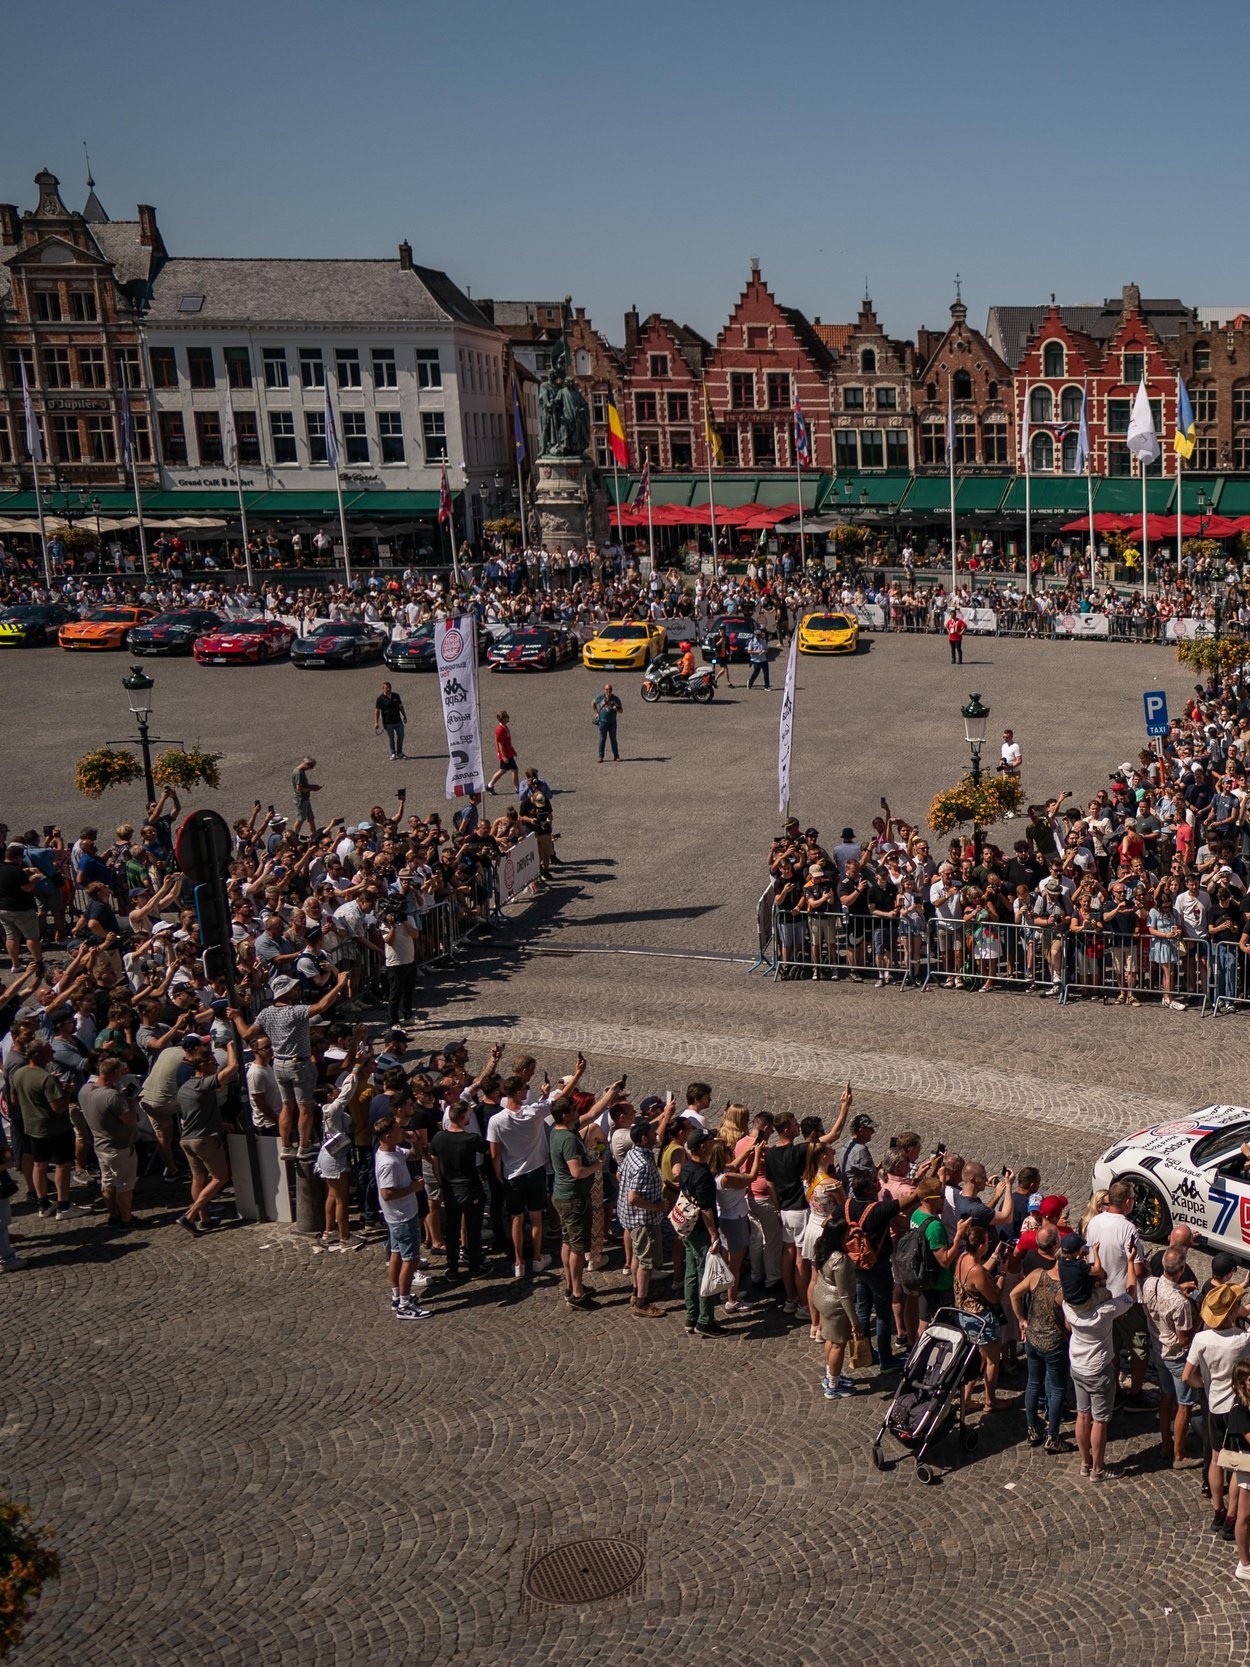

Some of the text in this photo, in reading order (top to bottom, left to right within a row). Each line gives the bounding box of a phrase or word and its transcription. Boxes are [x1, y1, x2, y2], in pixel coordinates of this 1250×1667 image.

[58, 399, 98, 410] Jupiler
[178, 478, 255, 487] Grand Café Befort
[1146, 696, 1163, 720] P
[1172, 1194, 1206, 1214] Kappa
[1171, 1212, 1208, 1229] VELOCE
